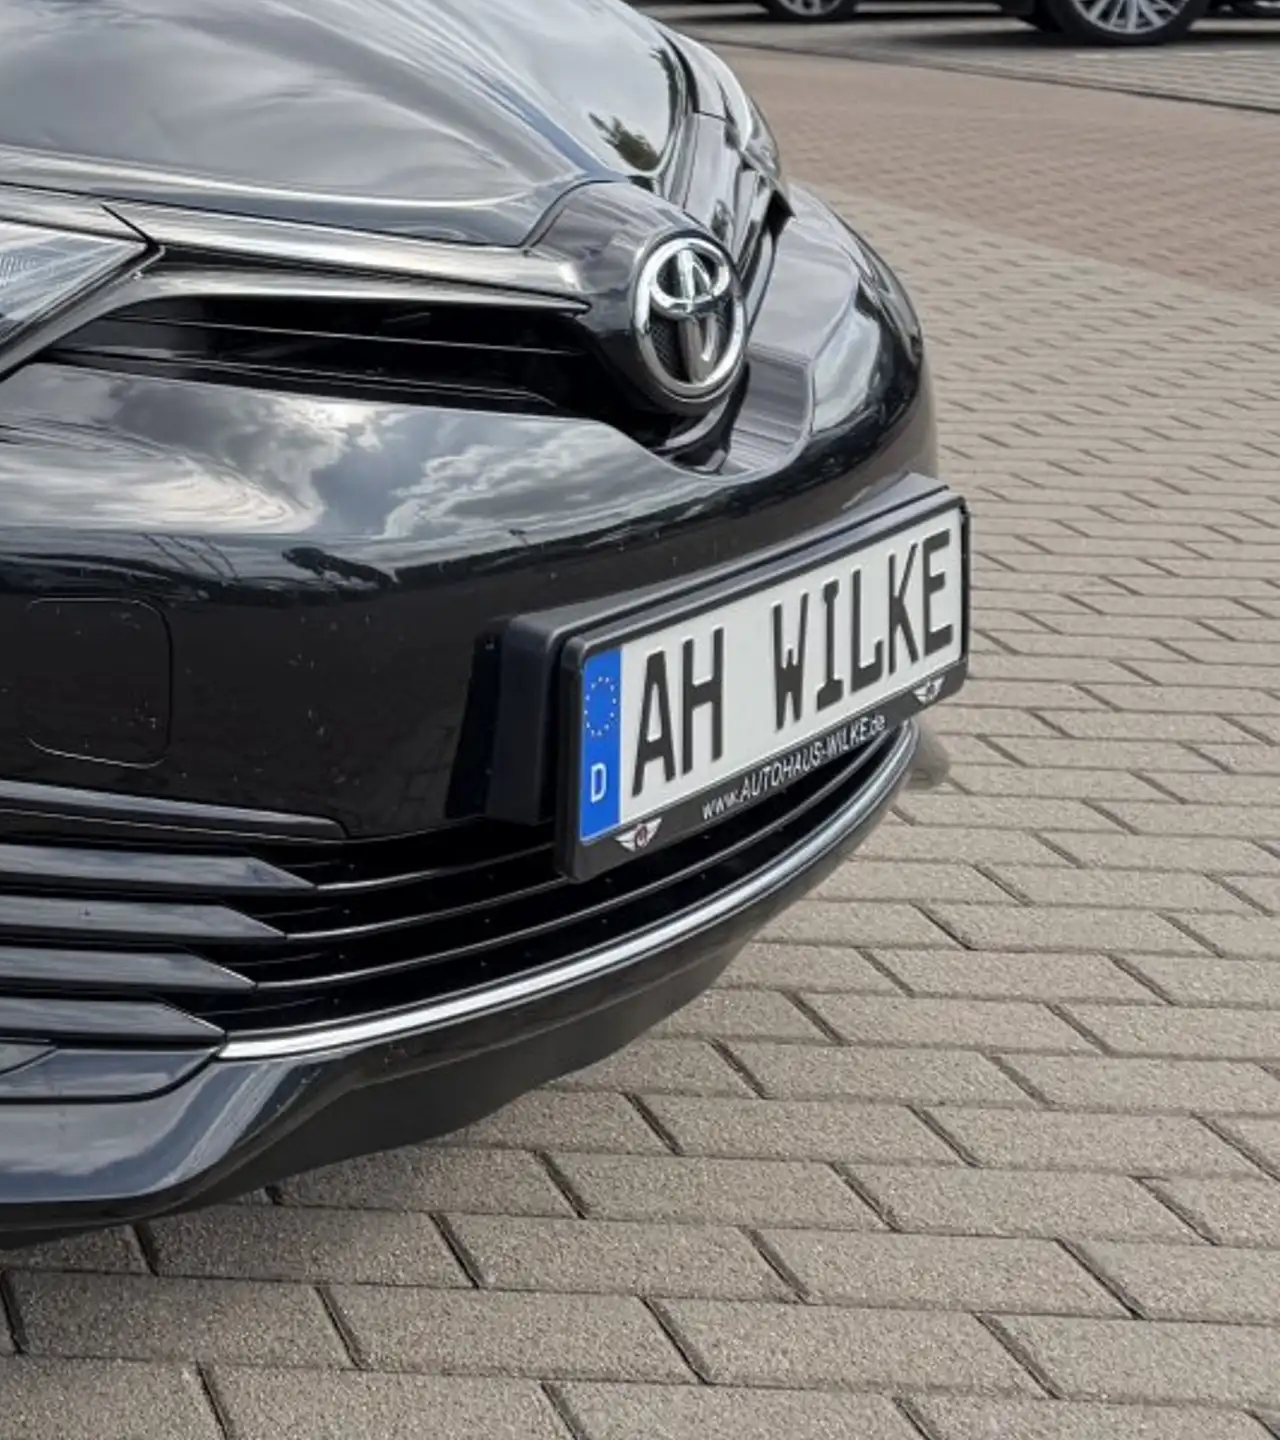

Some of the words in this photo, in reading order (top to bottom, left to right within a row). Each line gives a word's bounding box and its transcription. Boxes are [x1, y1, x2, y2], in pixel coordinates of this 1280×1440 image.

[632, 627, 725, 798] AH
[772, 528, 954, 732] WILKE
[589, 761, 608, 804] D
[701, 714, 886, 821] www.AUTOHAUS-WILKE.de
